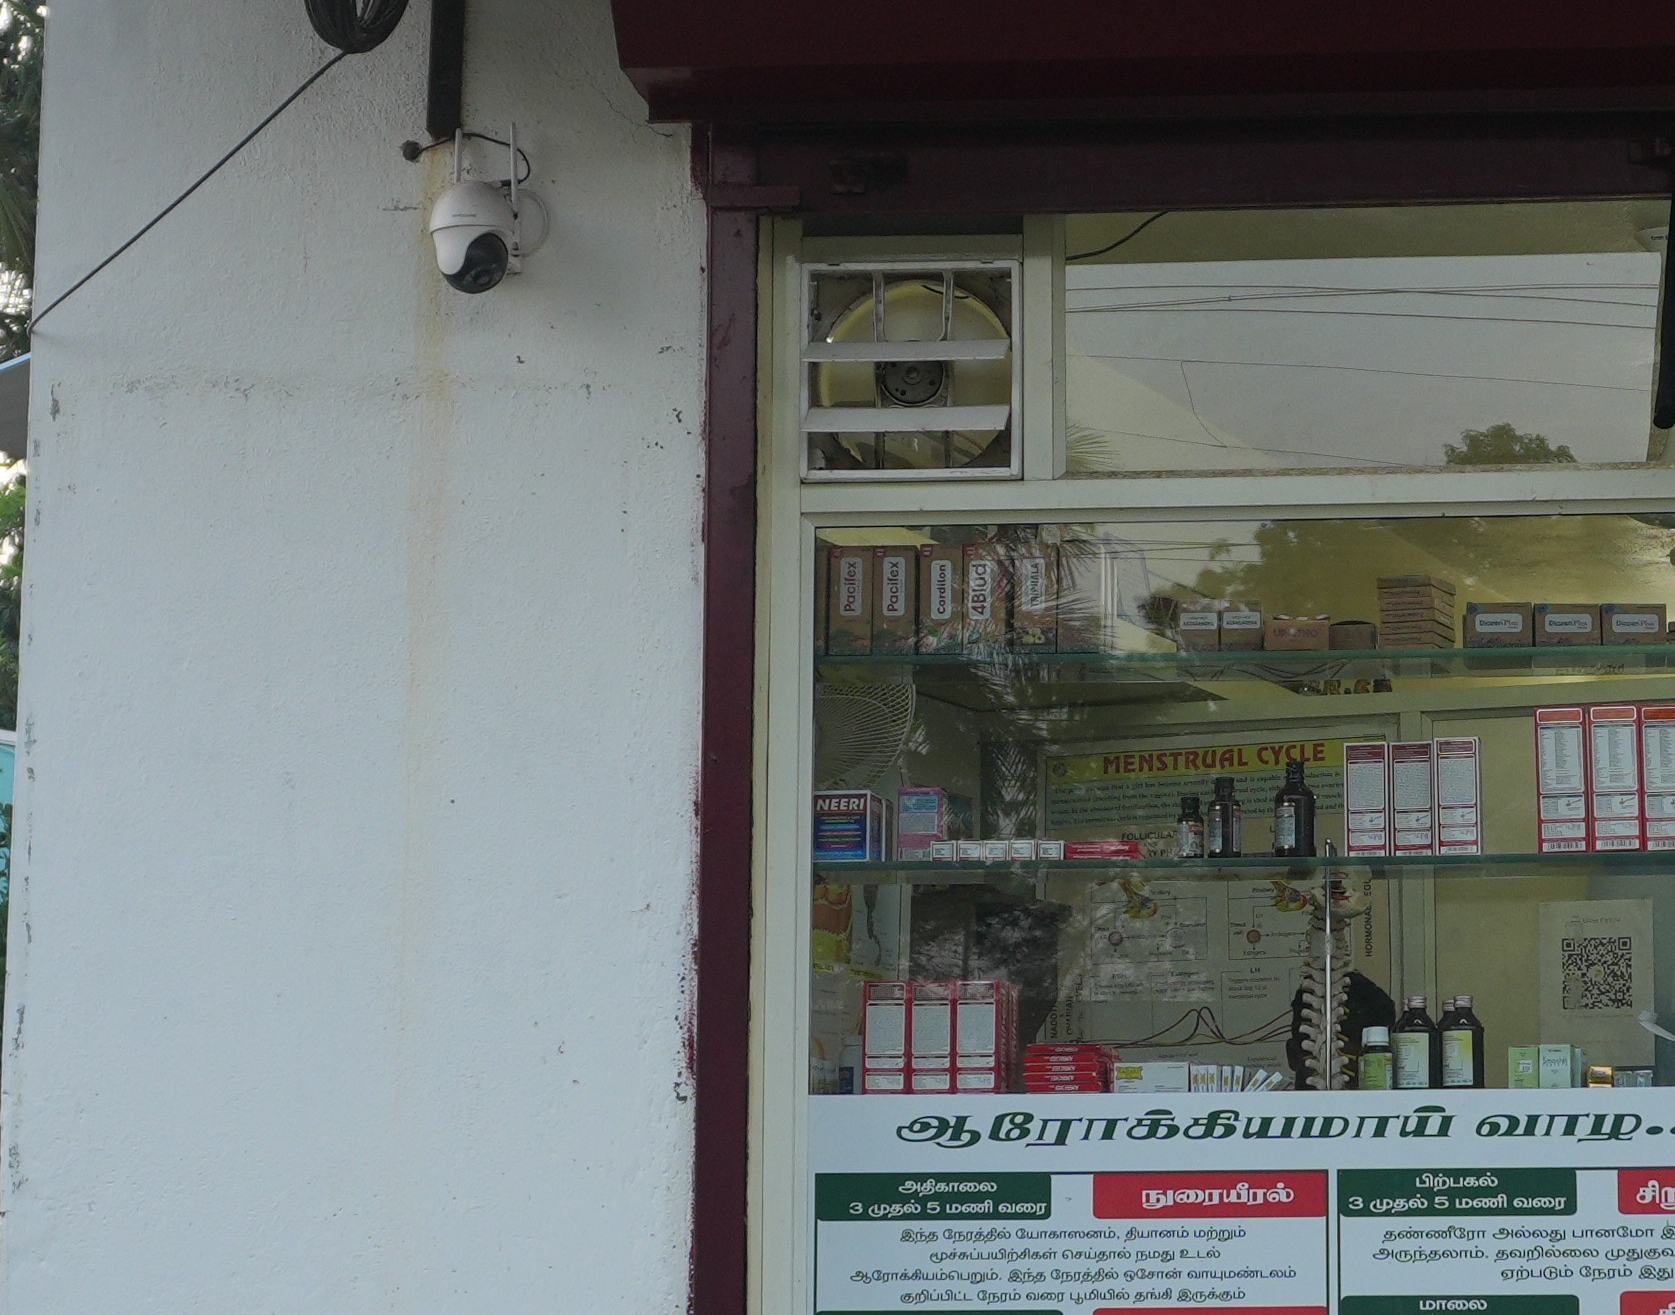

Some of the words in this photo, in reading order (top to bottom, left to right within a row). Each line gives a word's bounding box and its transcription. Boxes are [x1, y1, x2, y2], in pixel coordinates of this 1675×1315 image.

[844, 560, 857, 613] Pacifex
[887, 561, 900, 613] Pacifex
[1103, 748, 1249, 775] MENSTRUAL
[1256, 743, 1326, 766] CYCLE
[816, 798, 865, 811] NEERI
[895, 1104, 1457, 1149] ஆரோக்கியமாய்
[1416, 1172, 1498, 1191] பிற்பகல்
[899, 1179, 997, 1196] அதிகாலை
[1142, 1182, 1294, 1209] நுரையீரல்
[1349, 1197, 1363, 1209] 3
[1370, 1194, 1428, 1213] முதல்
[1434, 1196, 1449, 1208] 5
[1456, 1194, 1507, 1208] மணி
[1513, 1197, 1566, 1210] வரை
[849, 1202, 863, 1214] 3
[869, 1200, 921, 1218] முதல்
[927, 1202, 940, 1213] 5
[946, 1200, 992, 1213] மணி
[998, 1203, 1047, 1215] வரை
[900, 1228, 938, 1244] இந்த
[943, 1227, 1011, 1244] நேரத்தில்
[1124, 1226, 1189, 1242] தியானம்
[1194, 1225, 1246, 1242] மற்றும்
[1382, 1225, 1486, 1243] தண்ணீரோ
[1493, 1226, 1565, 1243] அல்லது
[1573, 1226, 1654, 1238] பானமோ
[1062, 1247, 1131, 1263] செய்தால்
[1135, 1251, 1174, 1263] நமது
[1180, 1246, 1220, 1258] உடல்
[1373, 1242, 1488, 1263] அருந்தலாம்.
[1494, 1245, 1599, 1262] தவறில்லை
[1008, 1268, 1046, 1284] இந்த
[1051, 1267, 1119, 1284] நேரத்தில்
[1124, 1268, 1182, 1282] ஒசோன்
[1187, 1266, 1296, 1281] வாயுமண்டலம்
[1501, 1264, 1573, 1282] ஏற்படும்
[1579, 1264, 1632, 1282] நேரம்
[900, 1289, 972, 1305] குறிப்பிட்ட
[977, 1289, 1021, 1305] நேரம்
[1026, 1292, 1065, 1302] வரை
[1070, 1288, 1129, 1304] பூமியில்
[1133, 1288, 1172, 1304] தங்கி
[1177, 1287, 1245, 1303] இருக்கும்
[1420, 1300, 1487, 1310] மாலை
